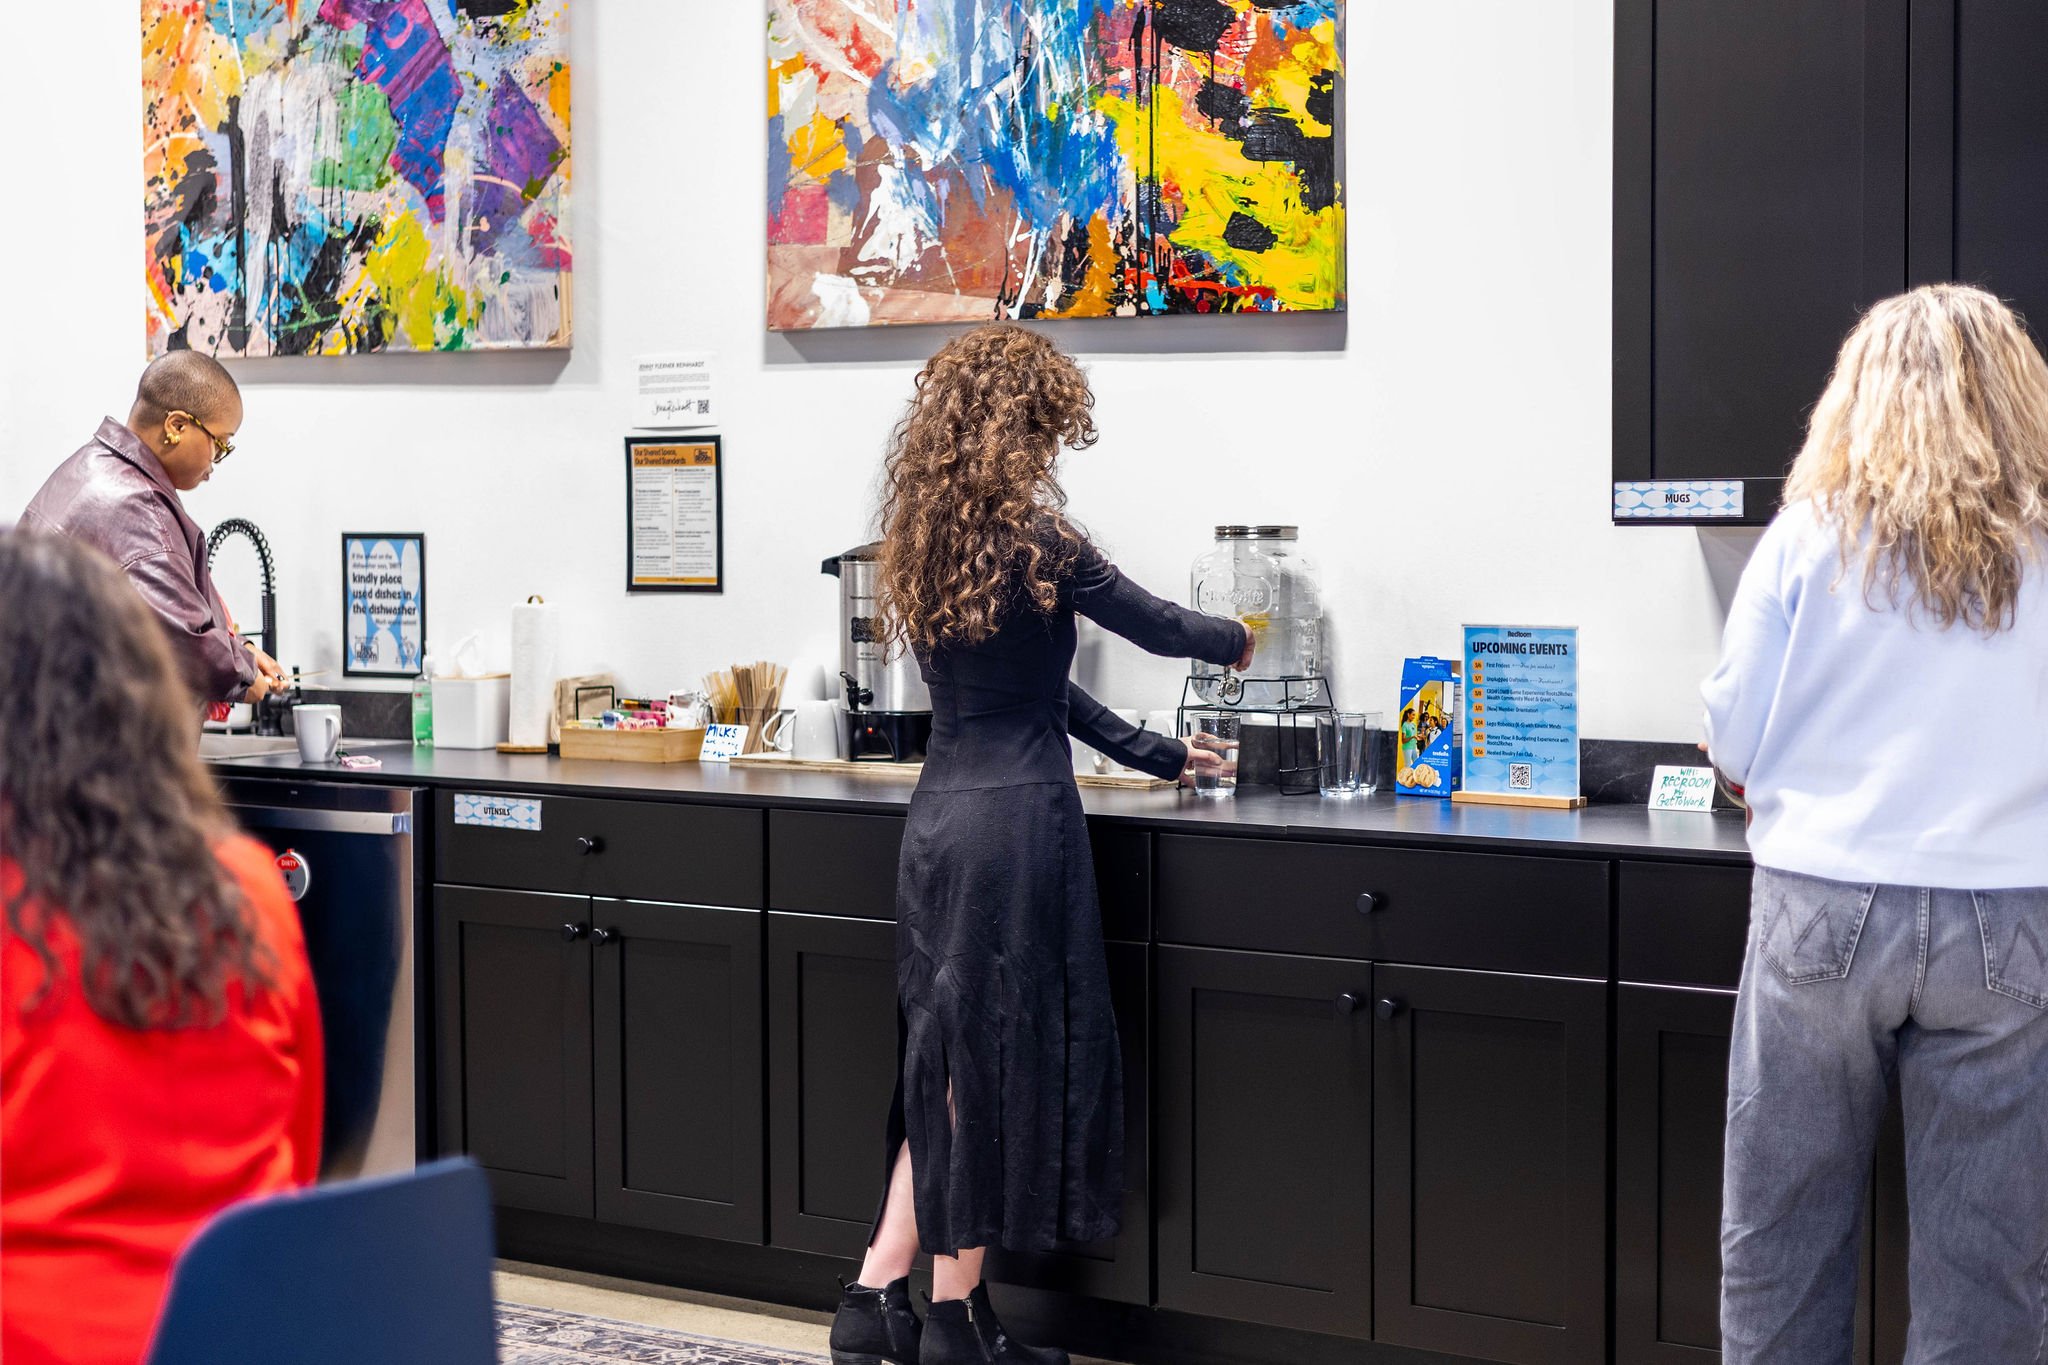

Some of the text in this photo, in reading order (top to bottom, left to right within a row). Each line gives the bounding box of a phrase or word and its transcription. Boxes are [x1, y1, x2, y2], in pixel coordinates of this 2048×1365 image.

[1665, 494, 1690, 504] MUGS
[352, 572, 402, 586] kindly place
[352, 588, 412, 600] used dishes in
[352, 603, 416, 616] the dishwasher
[1472, 642, 1568, 656] UPCOMING EVENTS
[706, 725, 738, 738] MILKS
[1660, 776, 1713, 790] RECROOM
[484, 806, 510, 816] UTENSILS
[281, 859, 296, 868] DIRTY
